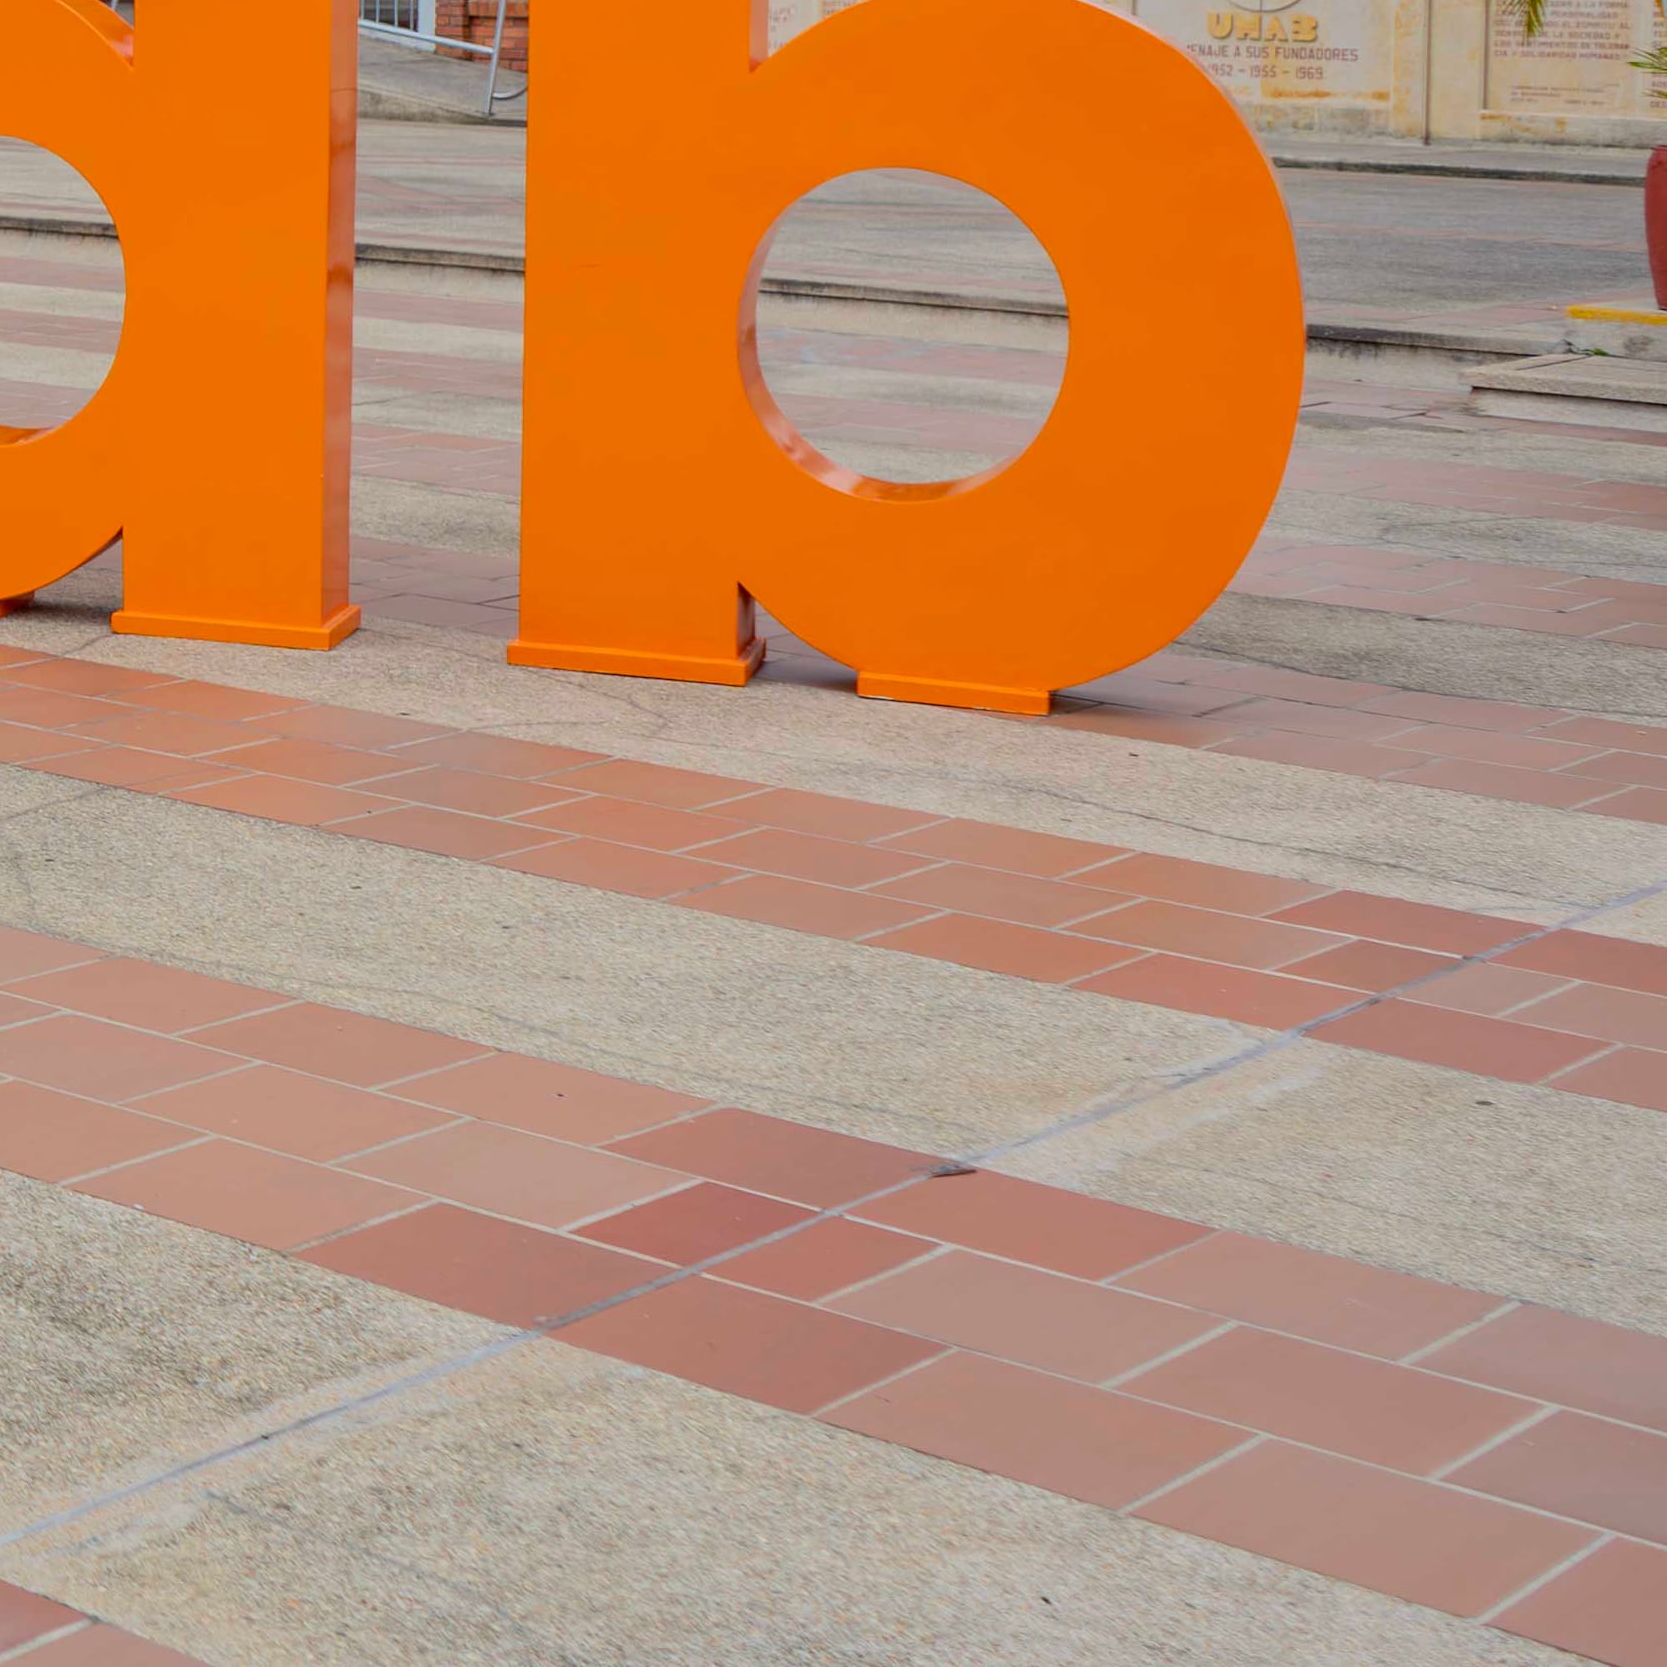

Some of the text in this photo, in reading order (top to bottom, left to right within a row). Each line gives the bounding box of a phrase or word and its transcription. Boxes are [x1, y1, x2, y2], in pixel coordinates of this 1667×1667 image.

[1207, 13, 1318, 42] UNAB
[1233, 45, 1241, 57] A
[1246, 46, 1270, 58] SUS
[1275, 46, 1359, 62] FUNDADORES
[1250, 65, 1277, 78] 1955
[1296, 66, 1323, 80] 1969
